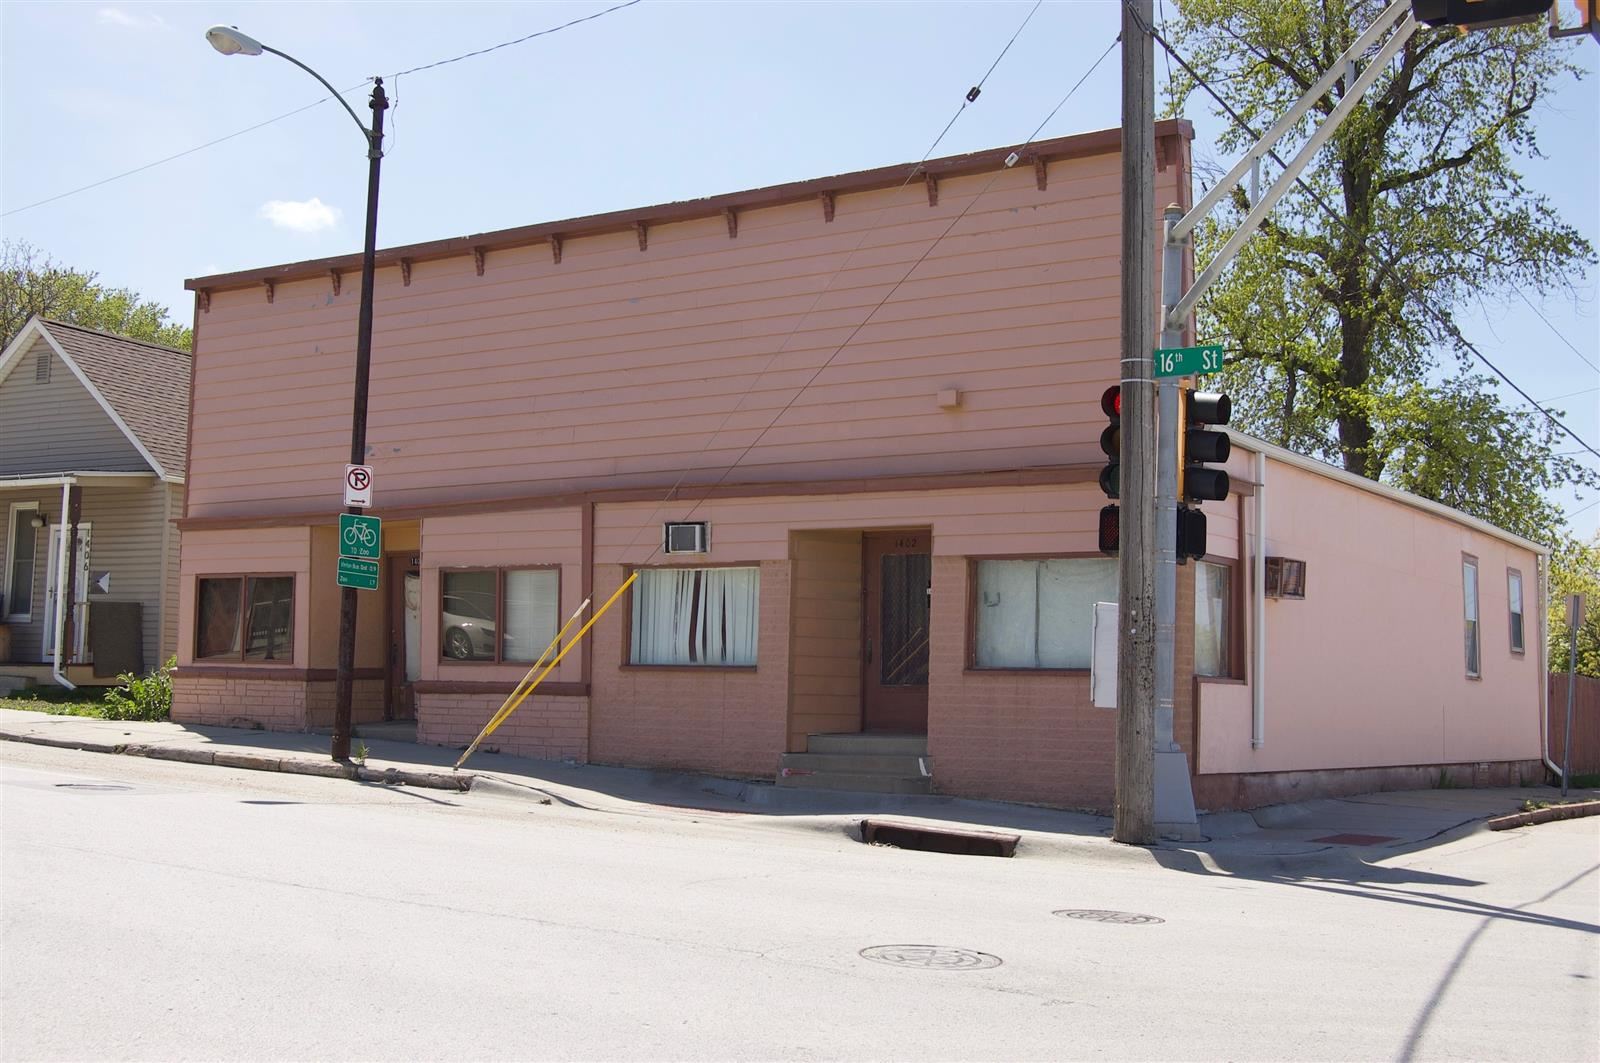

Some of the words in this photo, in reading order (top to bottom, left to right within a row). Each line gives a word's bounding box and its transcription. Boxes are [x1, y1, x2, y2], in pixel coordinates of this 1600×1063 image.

[1160, 353, 1183, 372] 16th
[1202, 350, 1218, 370] St
[896, 537, 917, 548] 1402
